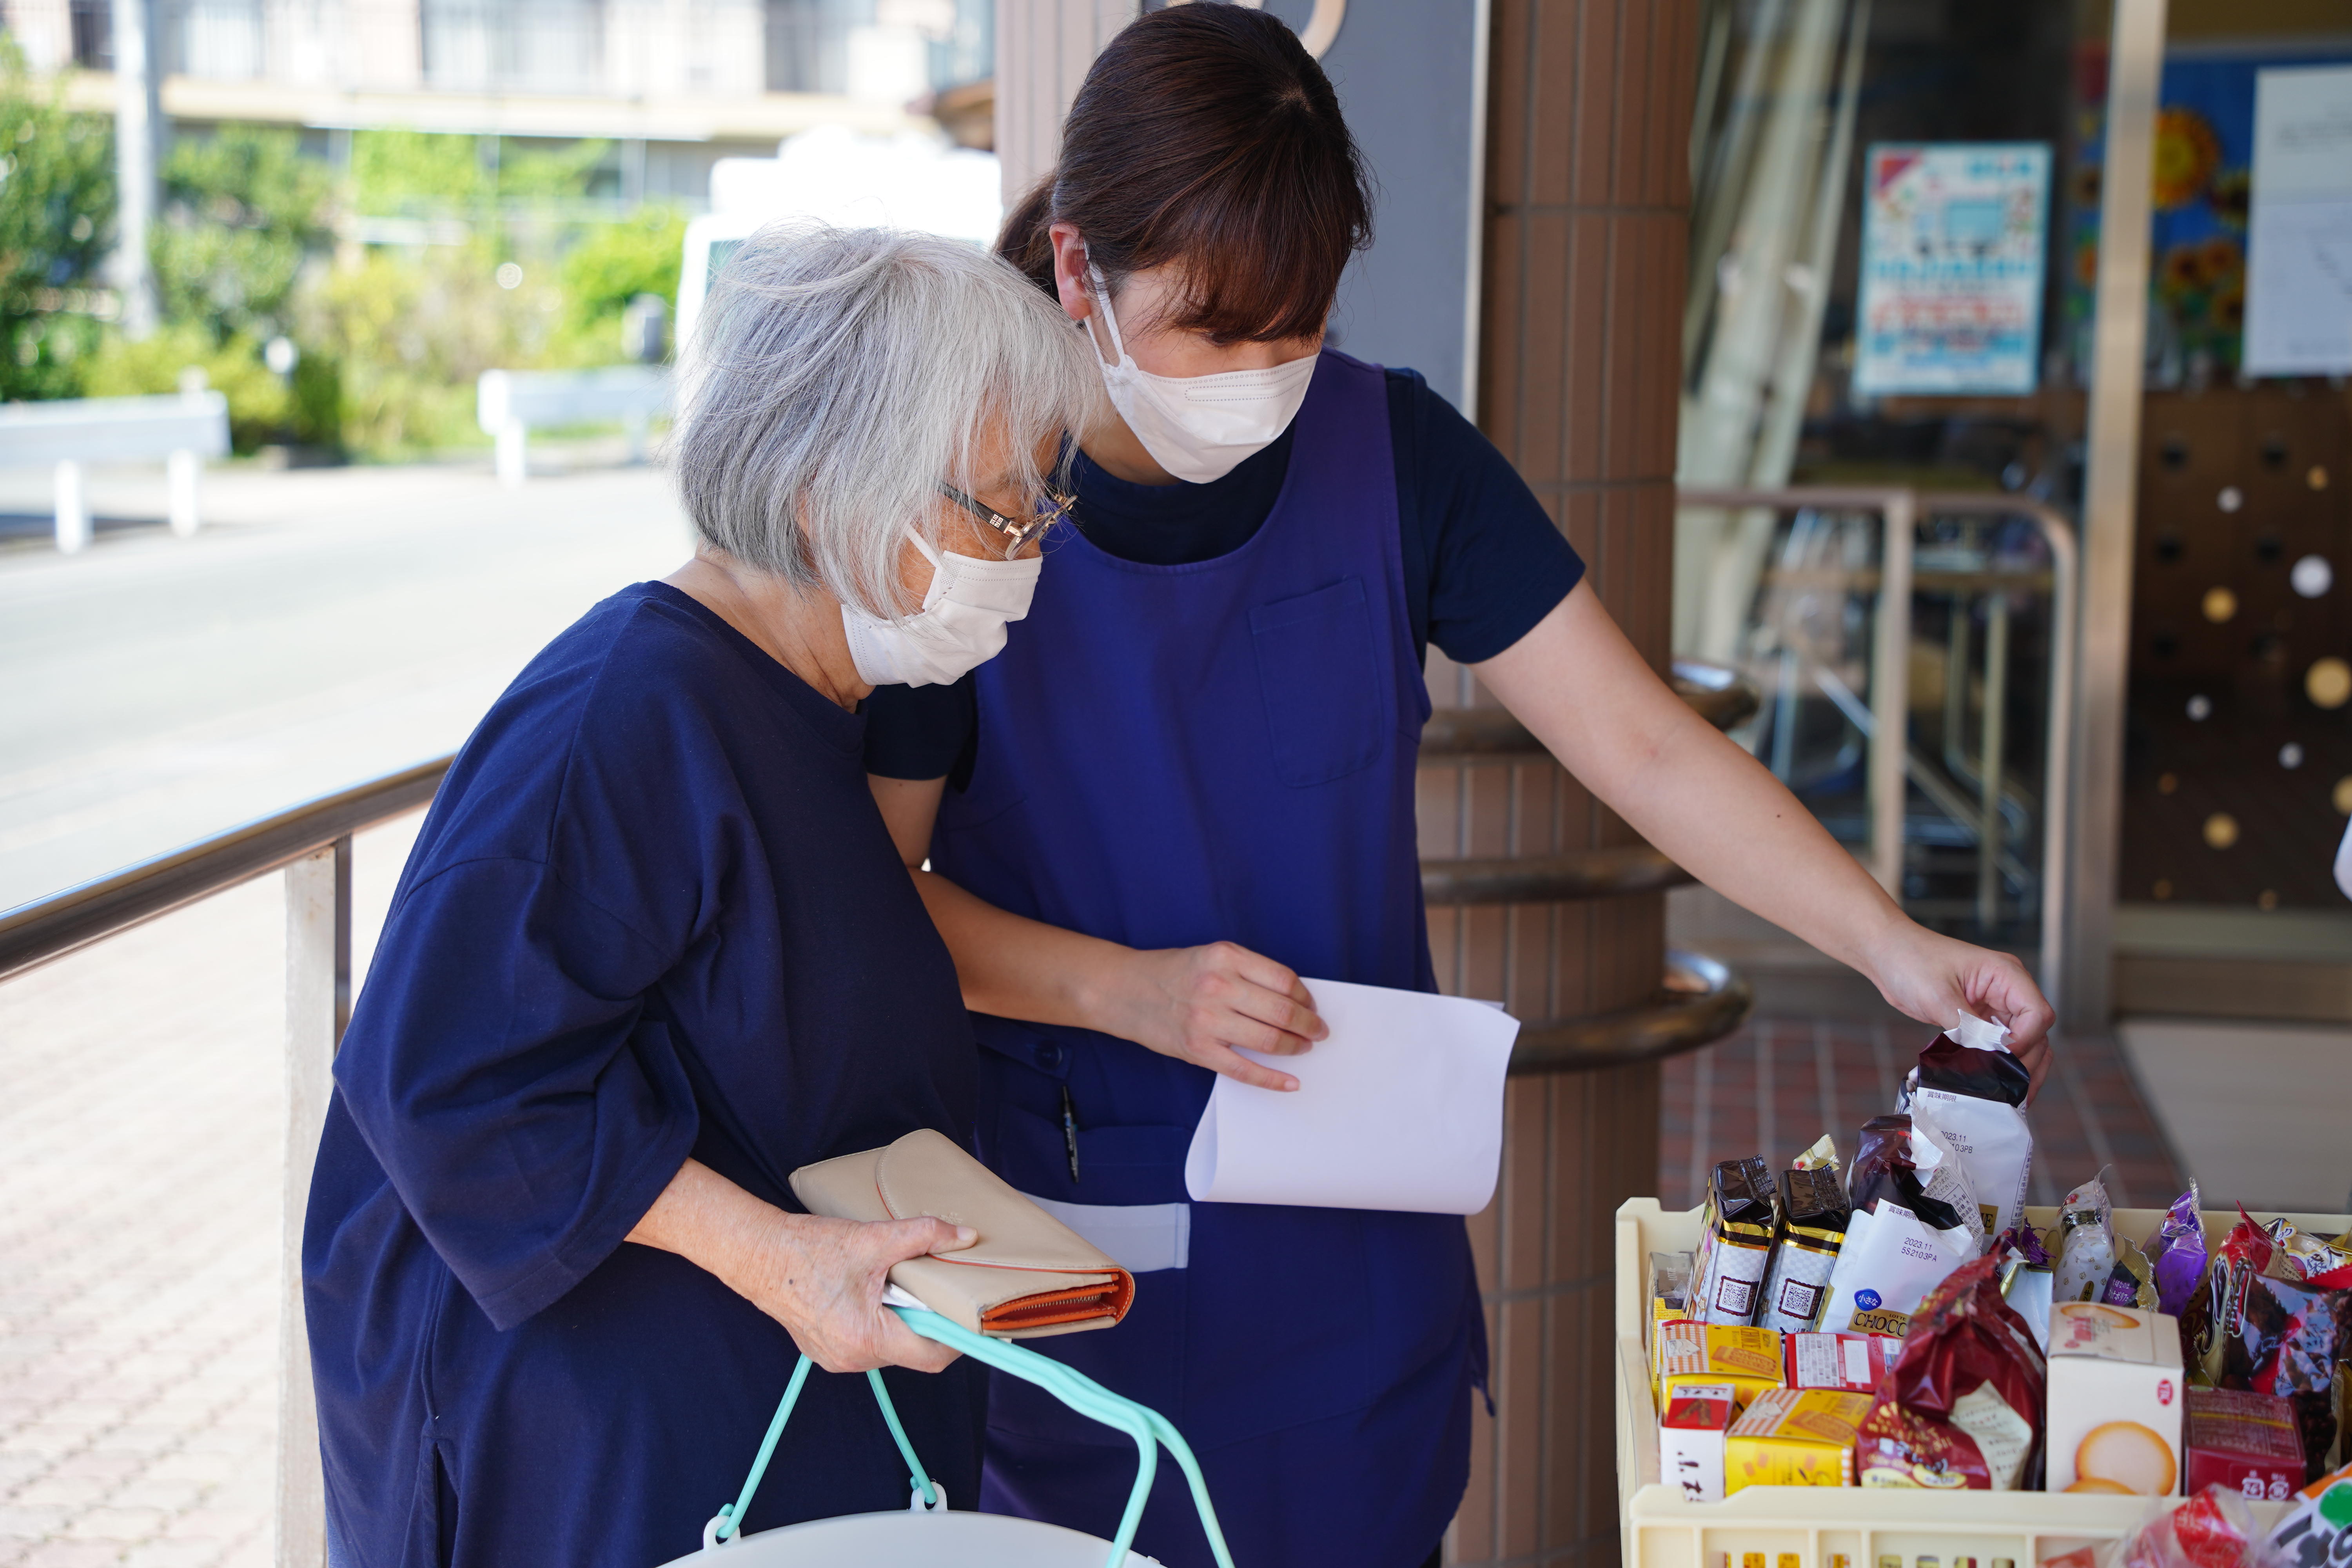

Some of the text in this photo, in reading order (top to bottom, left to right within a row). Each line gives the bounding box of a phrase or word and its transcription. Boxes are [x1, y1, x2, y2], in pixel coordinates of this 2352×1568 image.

[1927, 1091, 1957, 1102] 賞味期限
[1950, 1143, 1973, 1153] 103PB
[1888, 1205, 1918, 1221] 賞味期限
[1981, 1212, 1993, 1228] IE
[1904, 1237, 1932, 1250] 2023.11
[1901, 1247, 1937, 1262] 5S2103PA
[1858, 1294, 1878, 1307] 小さな
